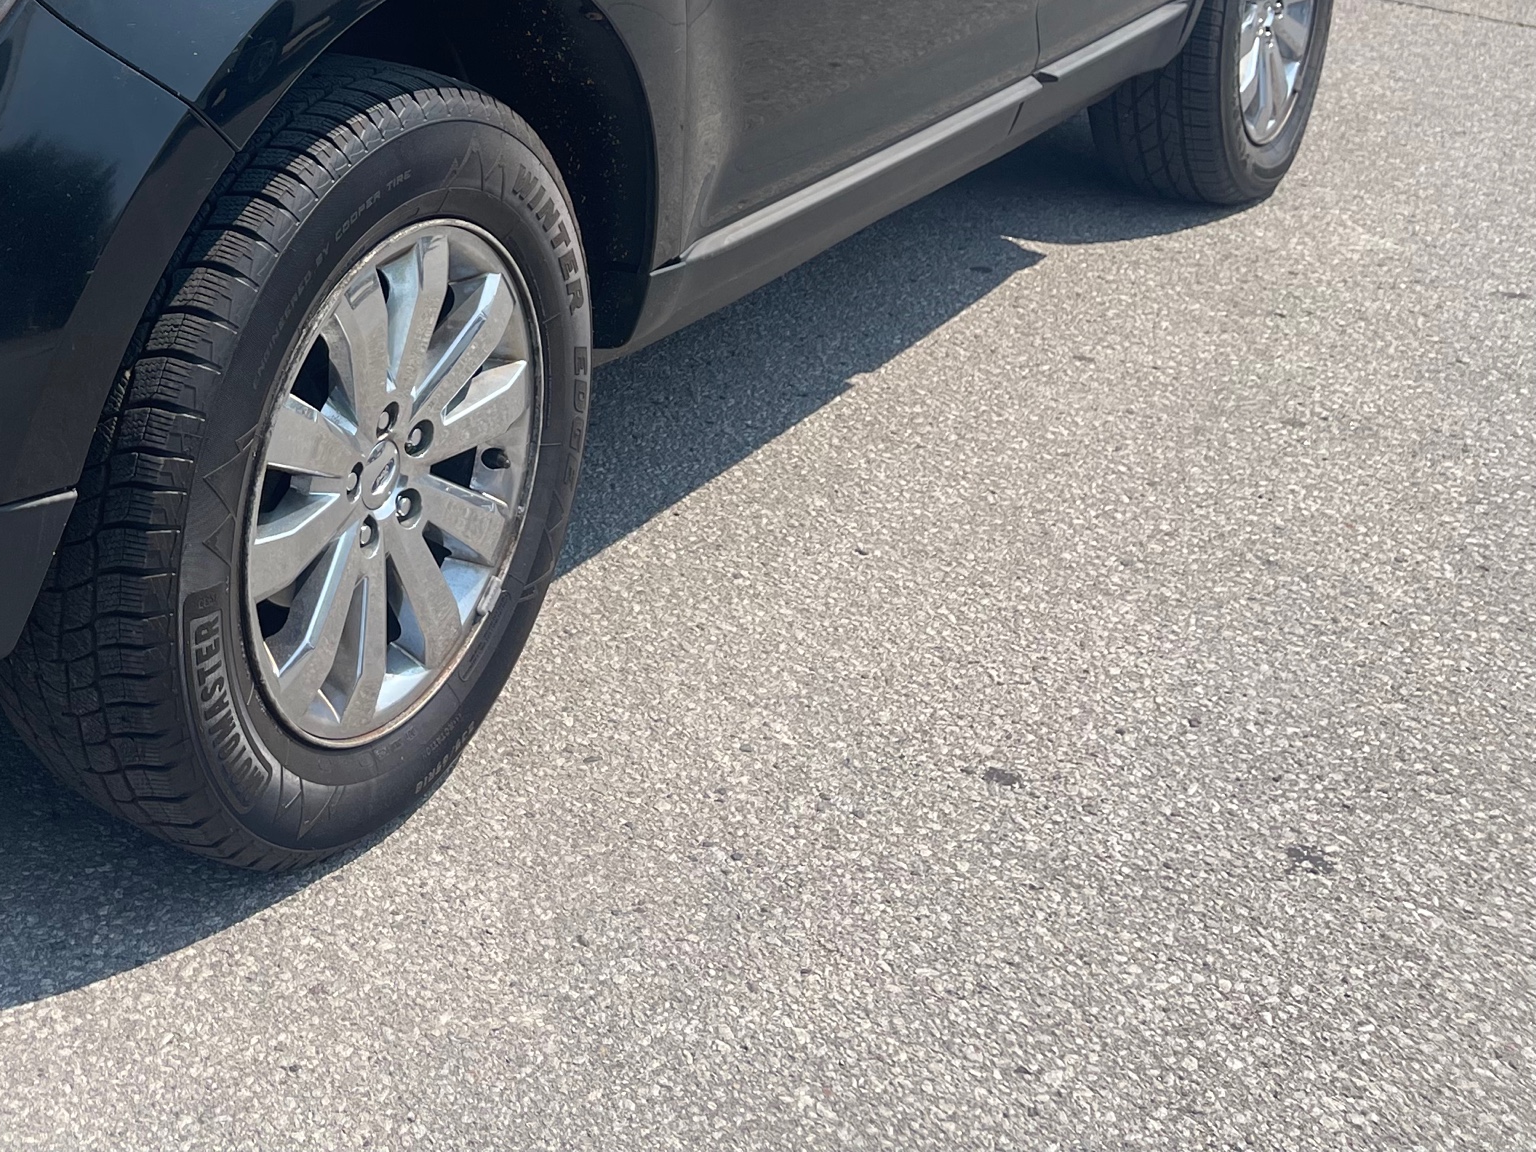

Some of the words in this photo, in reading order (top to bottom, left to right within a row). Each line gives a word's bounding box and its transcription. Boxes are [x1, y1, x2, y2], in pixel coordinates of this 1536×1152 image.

[334, 190, 382, 243] COOPER
[386, 168, 413, 192] TIRE
[511, 163, 587, 317] WINTER
[564, 346, 588, 486] EDGE
[194, 615, 267, 806] MOTOMASTER
